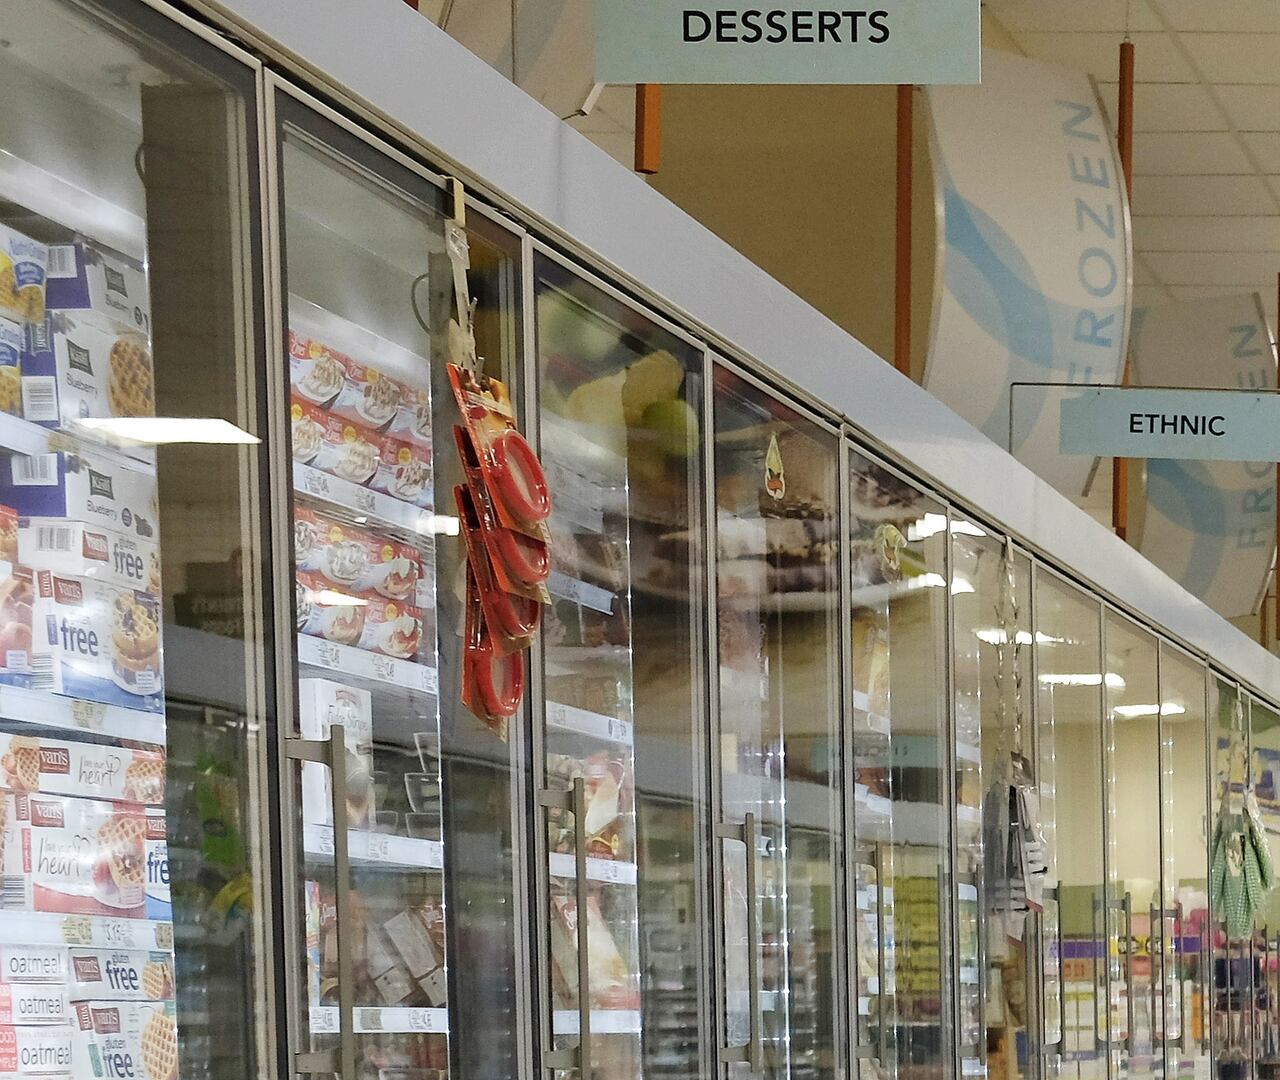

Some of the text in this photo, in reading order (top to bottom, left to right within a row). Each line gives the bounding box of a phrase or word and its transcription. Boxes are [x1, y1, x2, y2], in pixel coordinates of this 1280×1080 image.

[682, 10, 890, 43] DESSERTS
[1130, 413, 1226, 436] ETHNIC
[113, 544, 144, 579] free
[61, 618, 99, 657] free
[40, 750, 68, 766] van's
[35, 804, 62, 819] van's
[10, 953, 61, 974] oatmeal
[112, 953, 129, 967] gluten
[106, 961, 140, 990] free
[19, 996, 63, 1014] oatmeal
[95, 1012, 119, 1026] van's
[21, 1041, 73, 1065] oatmeal
[103, 1047, 133, 1078] free
